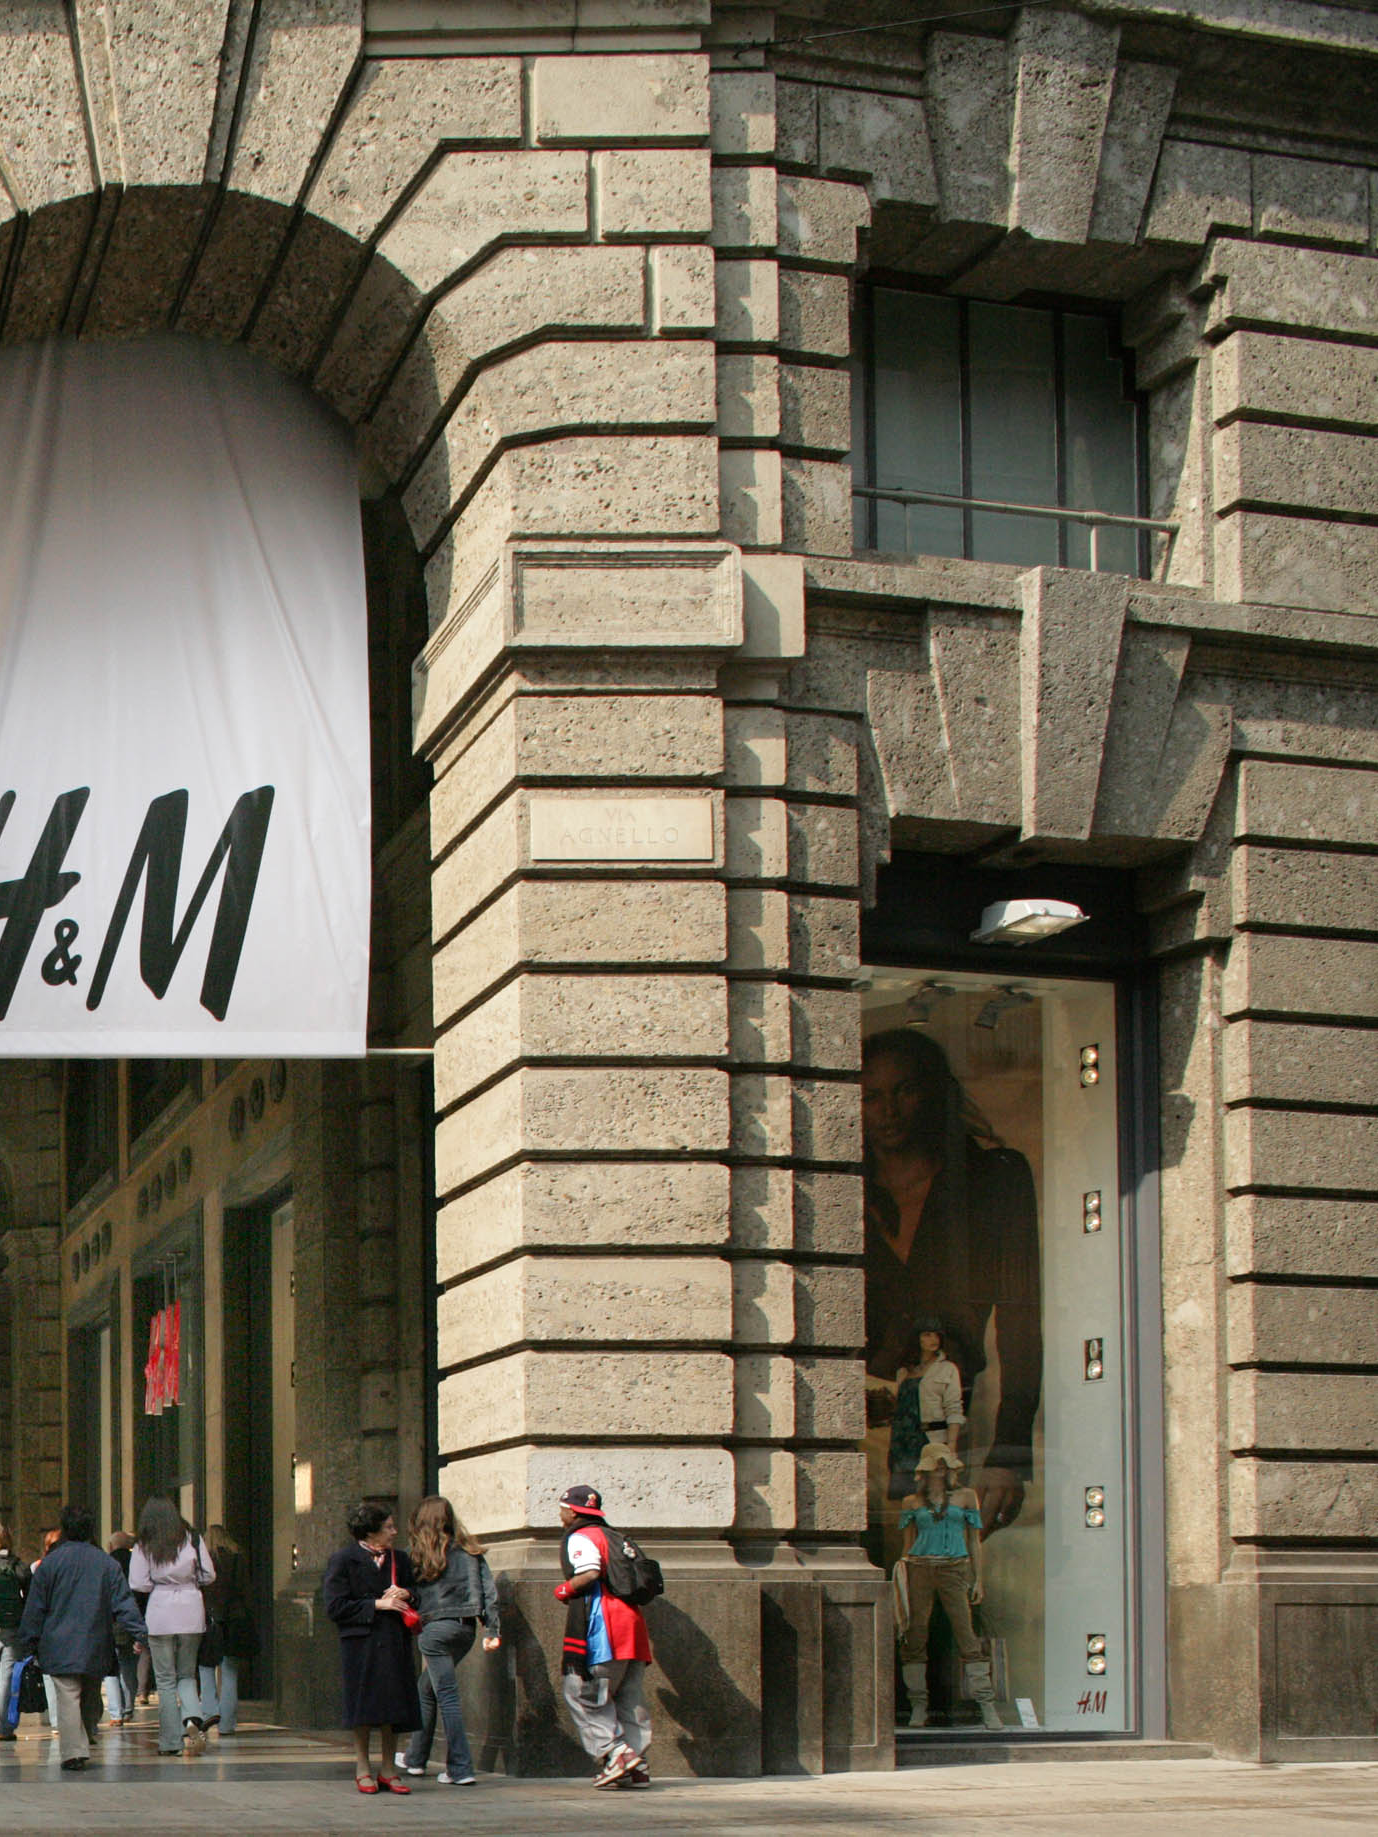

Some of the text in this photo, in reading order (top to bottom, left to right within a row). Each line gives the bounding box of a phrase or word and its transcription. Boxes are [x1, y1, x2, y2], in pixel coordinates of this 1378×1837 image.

[605, 808, 636, 823] VIA
[560, 827, 679, 845] AGNELLO
[1077, 1691, 1107, 1714] H&M
